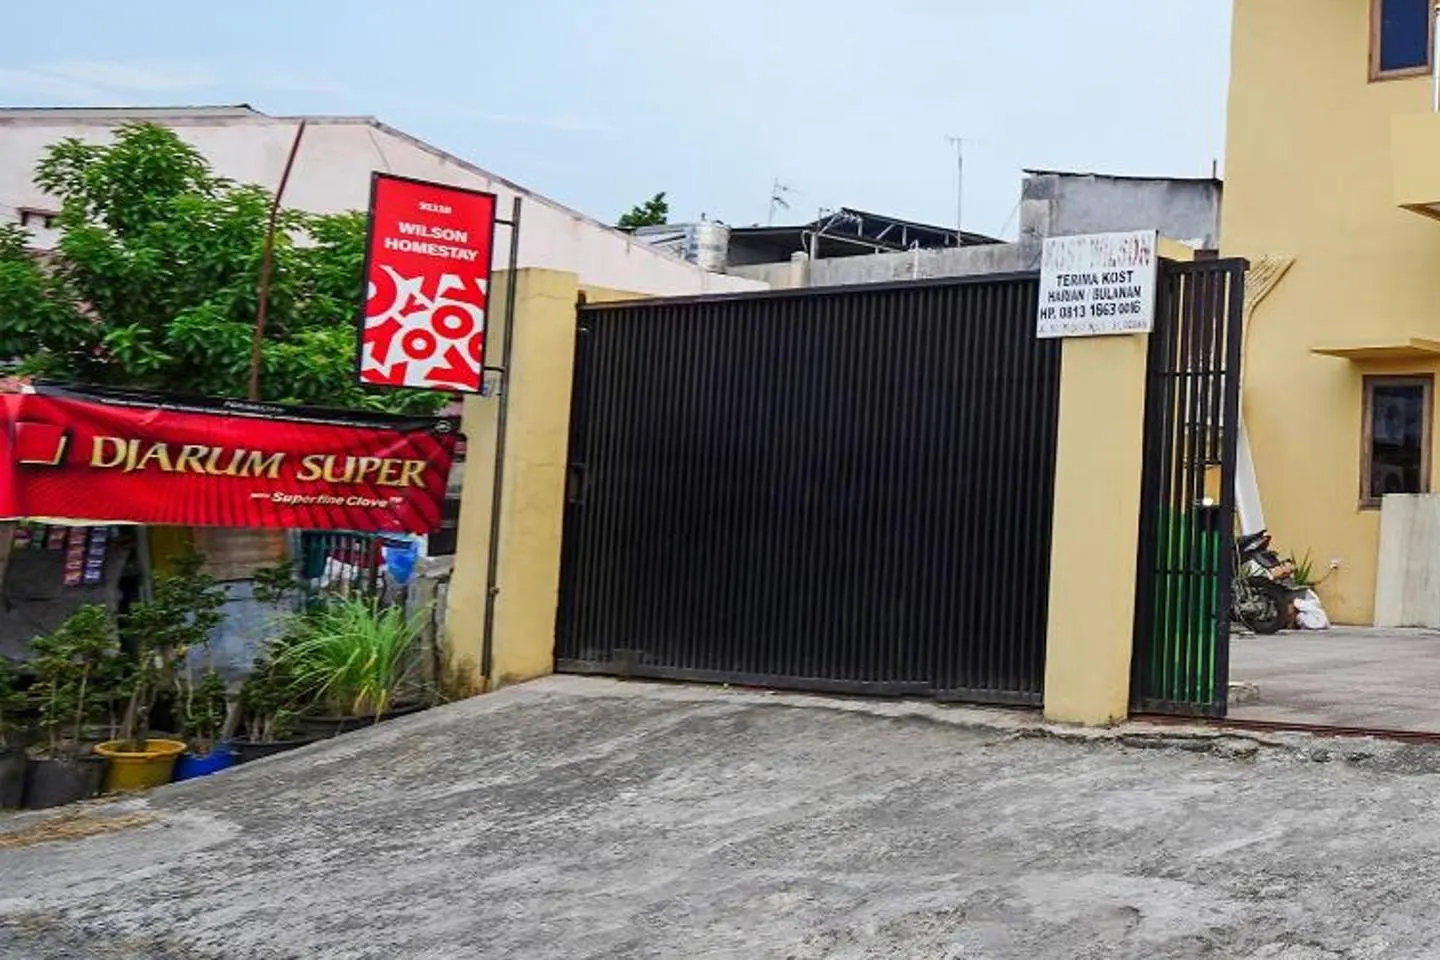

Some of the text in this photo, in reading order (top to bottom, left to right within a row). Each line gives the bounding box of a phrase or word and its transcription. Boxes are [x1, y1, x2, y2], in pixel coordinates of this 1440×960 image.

[398, 221, 468, 243] WILSON
[384, 237, 479, 261] HOMESTAY
[1056, 270, 1134, 287] TERIMA KOST
[89, 435, 427, 487] DJARUM SUPER
[271, 491, 345, 506] Superfine
